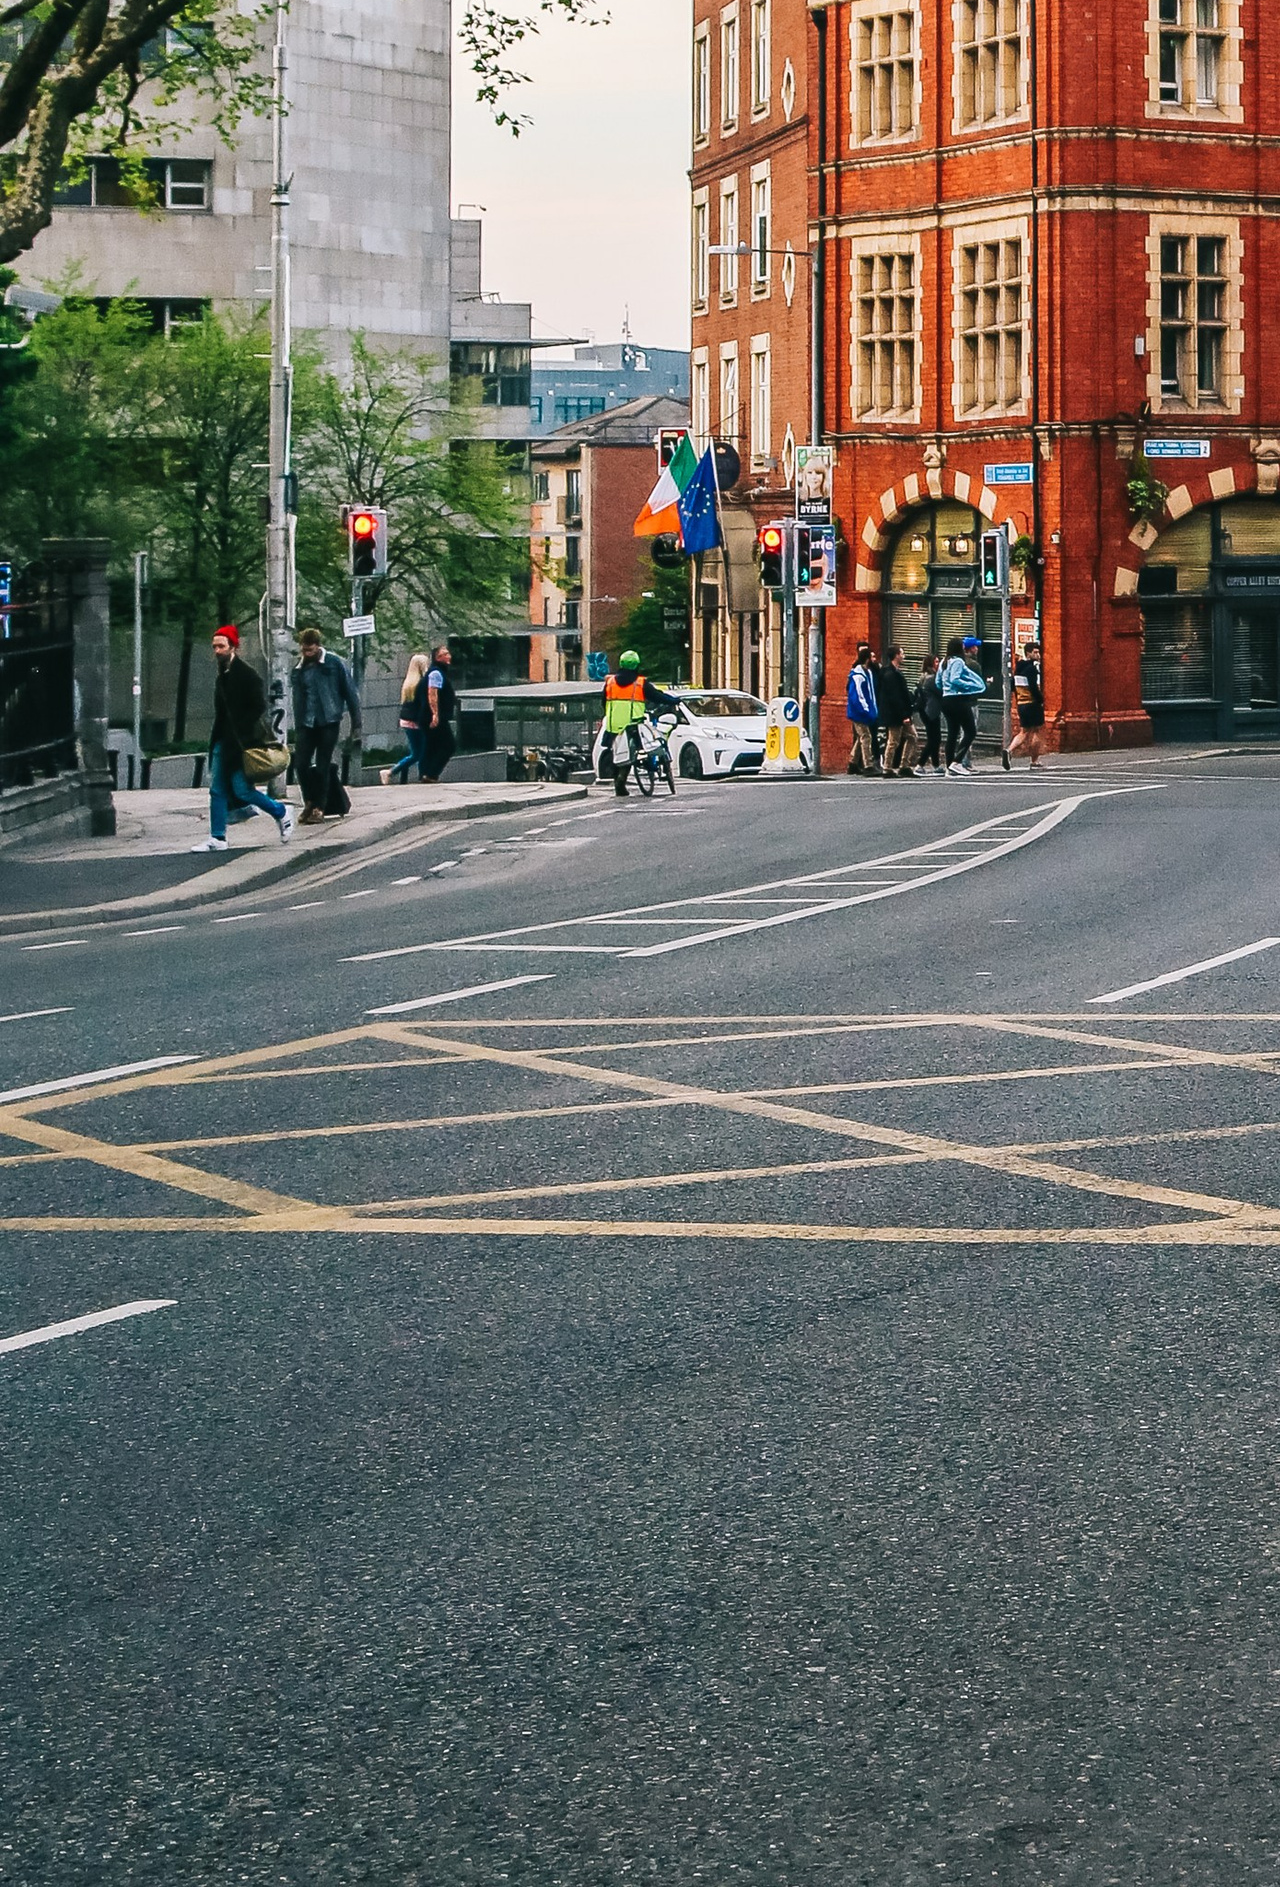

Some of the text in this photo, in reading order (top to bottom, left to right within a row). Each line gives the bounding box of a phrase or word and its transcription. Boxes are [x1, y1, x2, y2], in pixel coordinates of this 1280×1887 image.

[800, 505, 828, 514] BYRNE
[1226, 576, 1247, 586] COPPER
[1249, 576, 1266, 585] ALLEY
